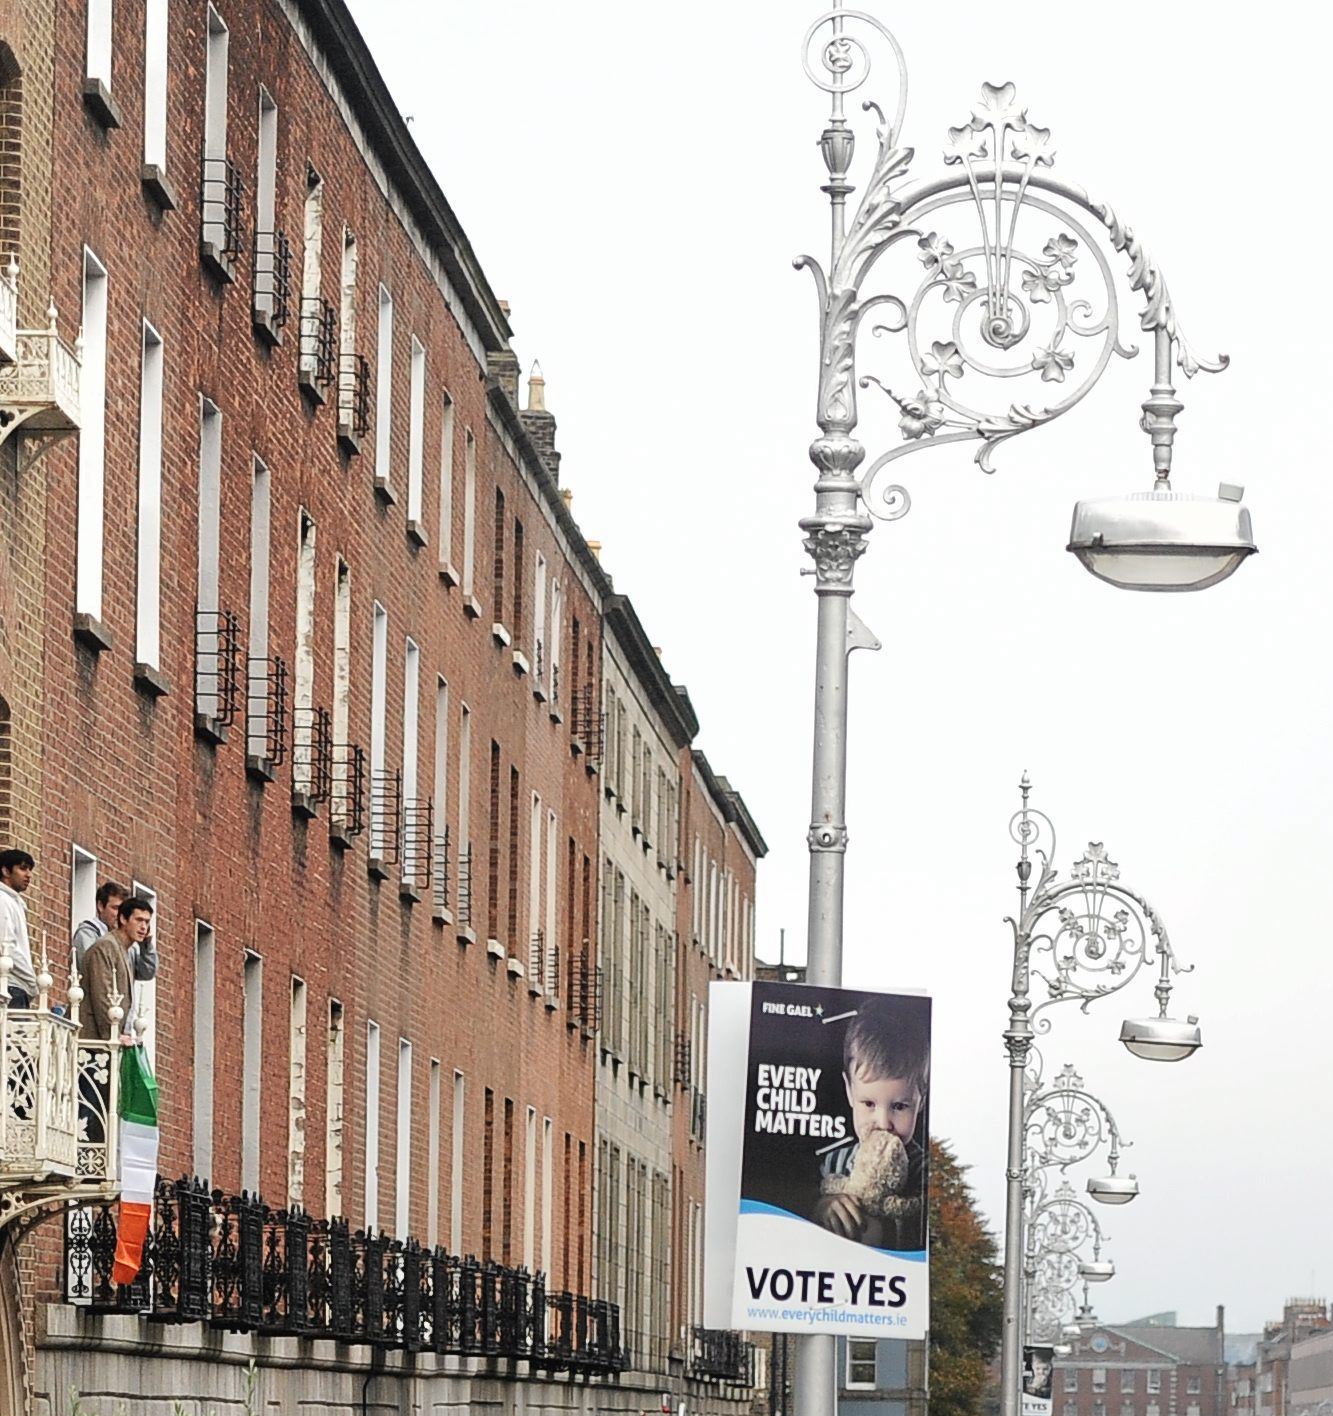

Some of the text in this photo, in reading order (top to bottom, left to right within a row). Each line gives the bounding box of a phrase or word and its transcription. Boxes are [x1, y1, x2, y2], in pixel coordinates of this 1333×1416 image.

[762, 1002, 813, 1017] FINE GAEL
[757, 1063, 822, 1091] EVERY
[756, 1087, 817, 1113] CHILD
[754, 1110, 847, 1139] MATTERS
[745, 1266, 907, 1308] VOTE YES
[747, 1307, 908, 1327] www.everychildmatters.ie
